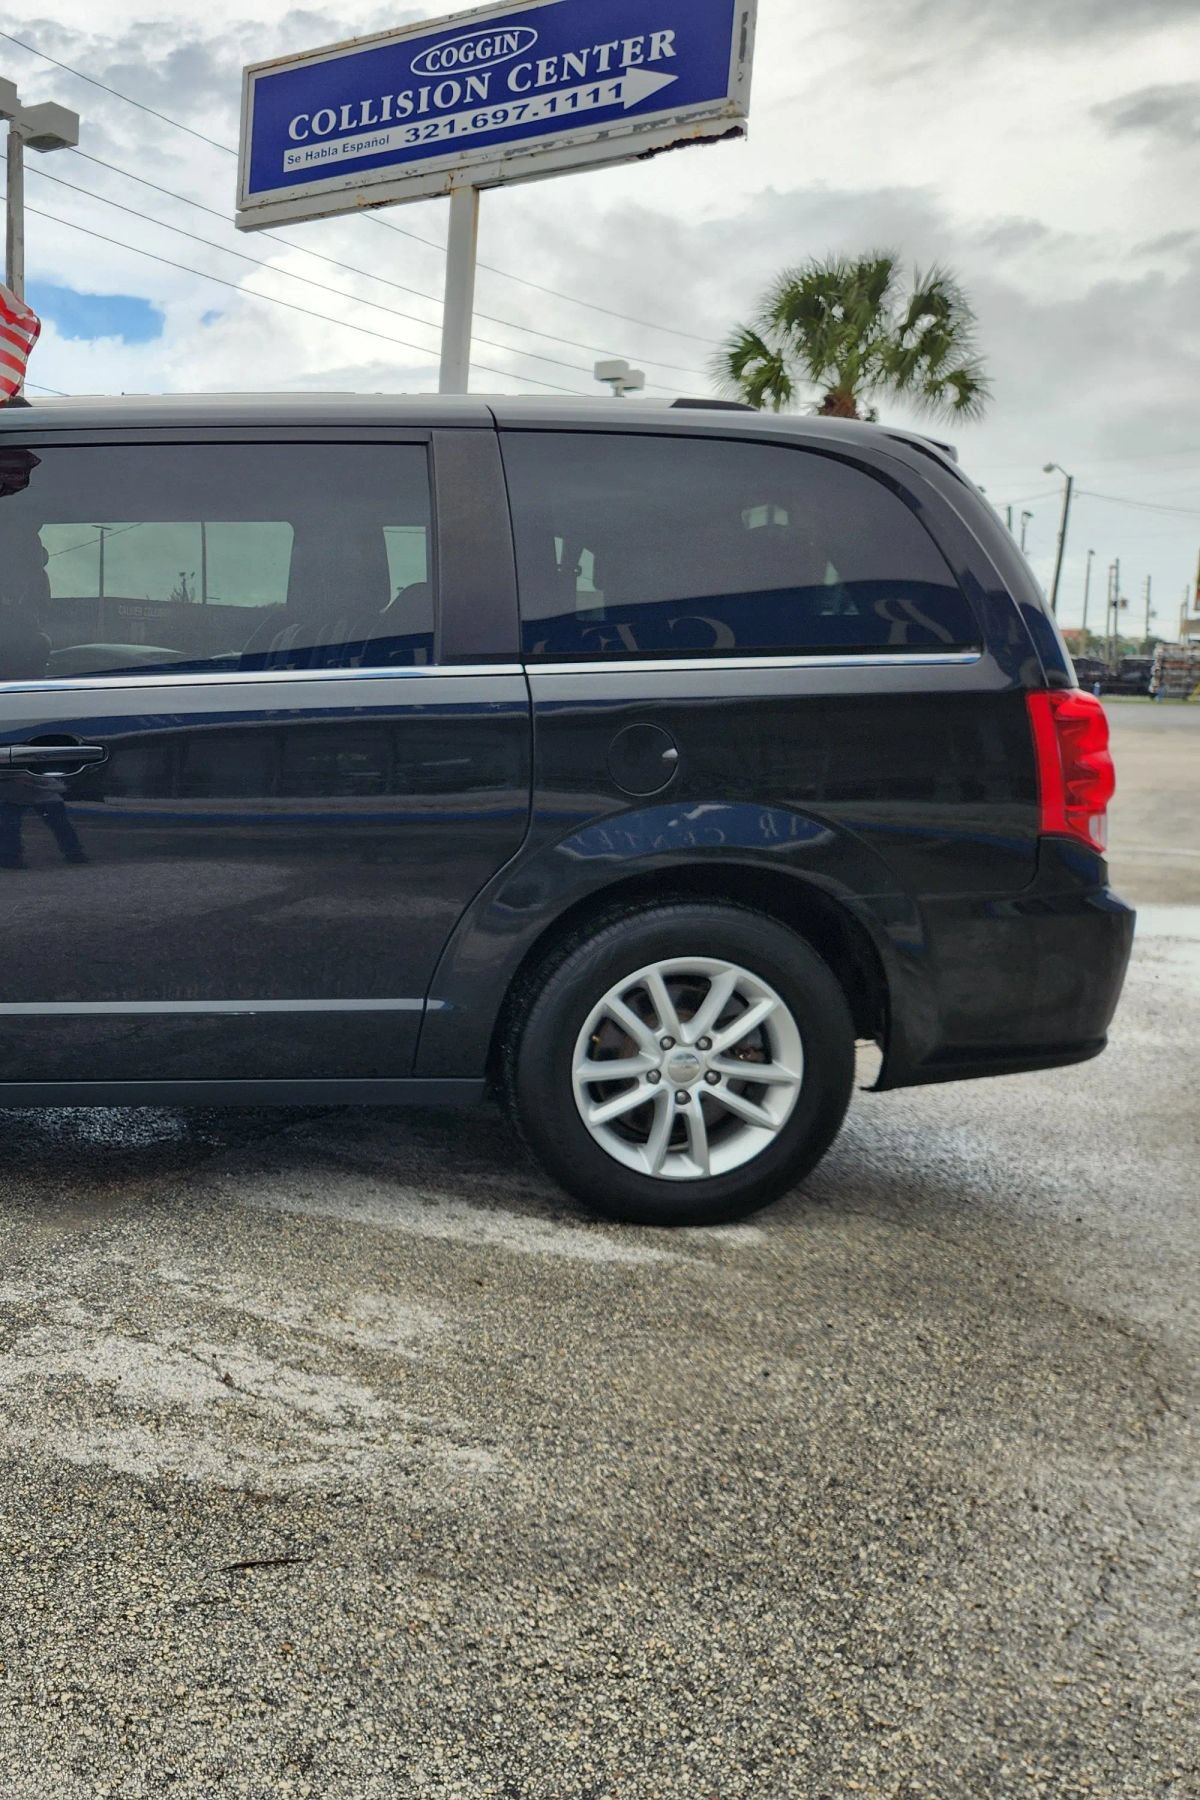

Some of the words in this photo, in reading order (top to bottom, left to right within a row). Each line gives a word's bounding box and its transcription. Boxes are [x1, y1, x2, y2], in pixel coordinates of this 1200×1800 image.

[425, 31, 520, 72] COGGIN
[288, 72, 492, 141] COLLISION
[507, 29, 677, 93] CENTER
[404, 83, 624, 143] 321.697.1111
[287, 154, 301, 165] Se
[305, 147, 338, 162] Habla
[342, 135, 390, 154] Español
